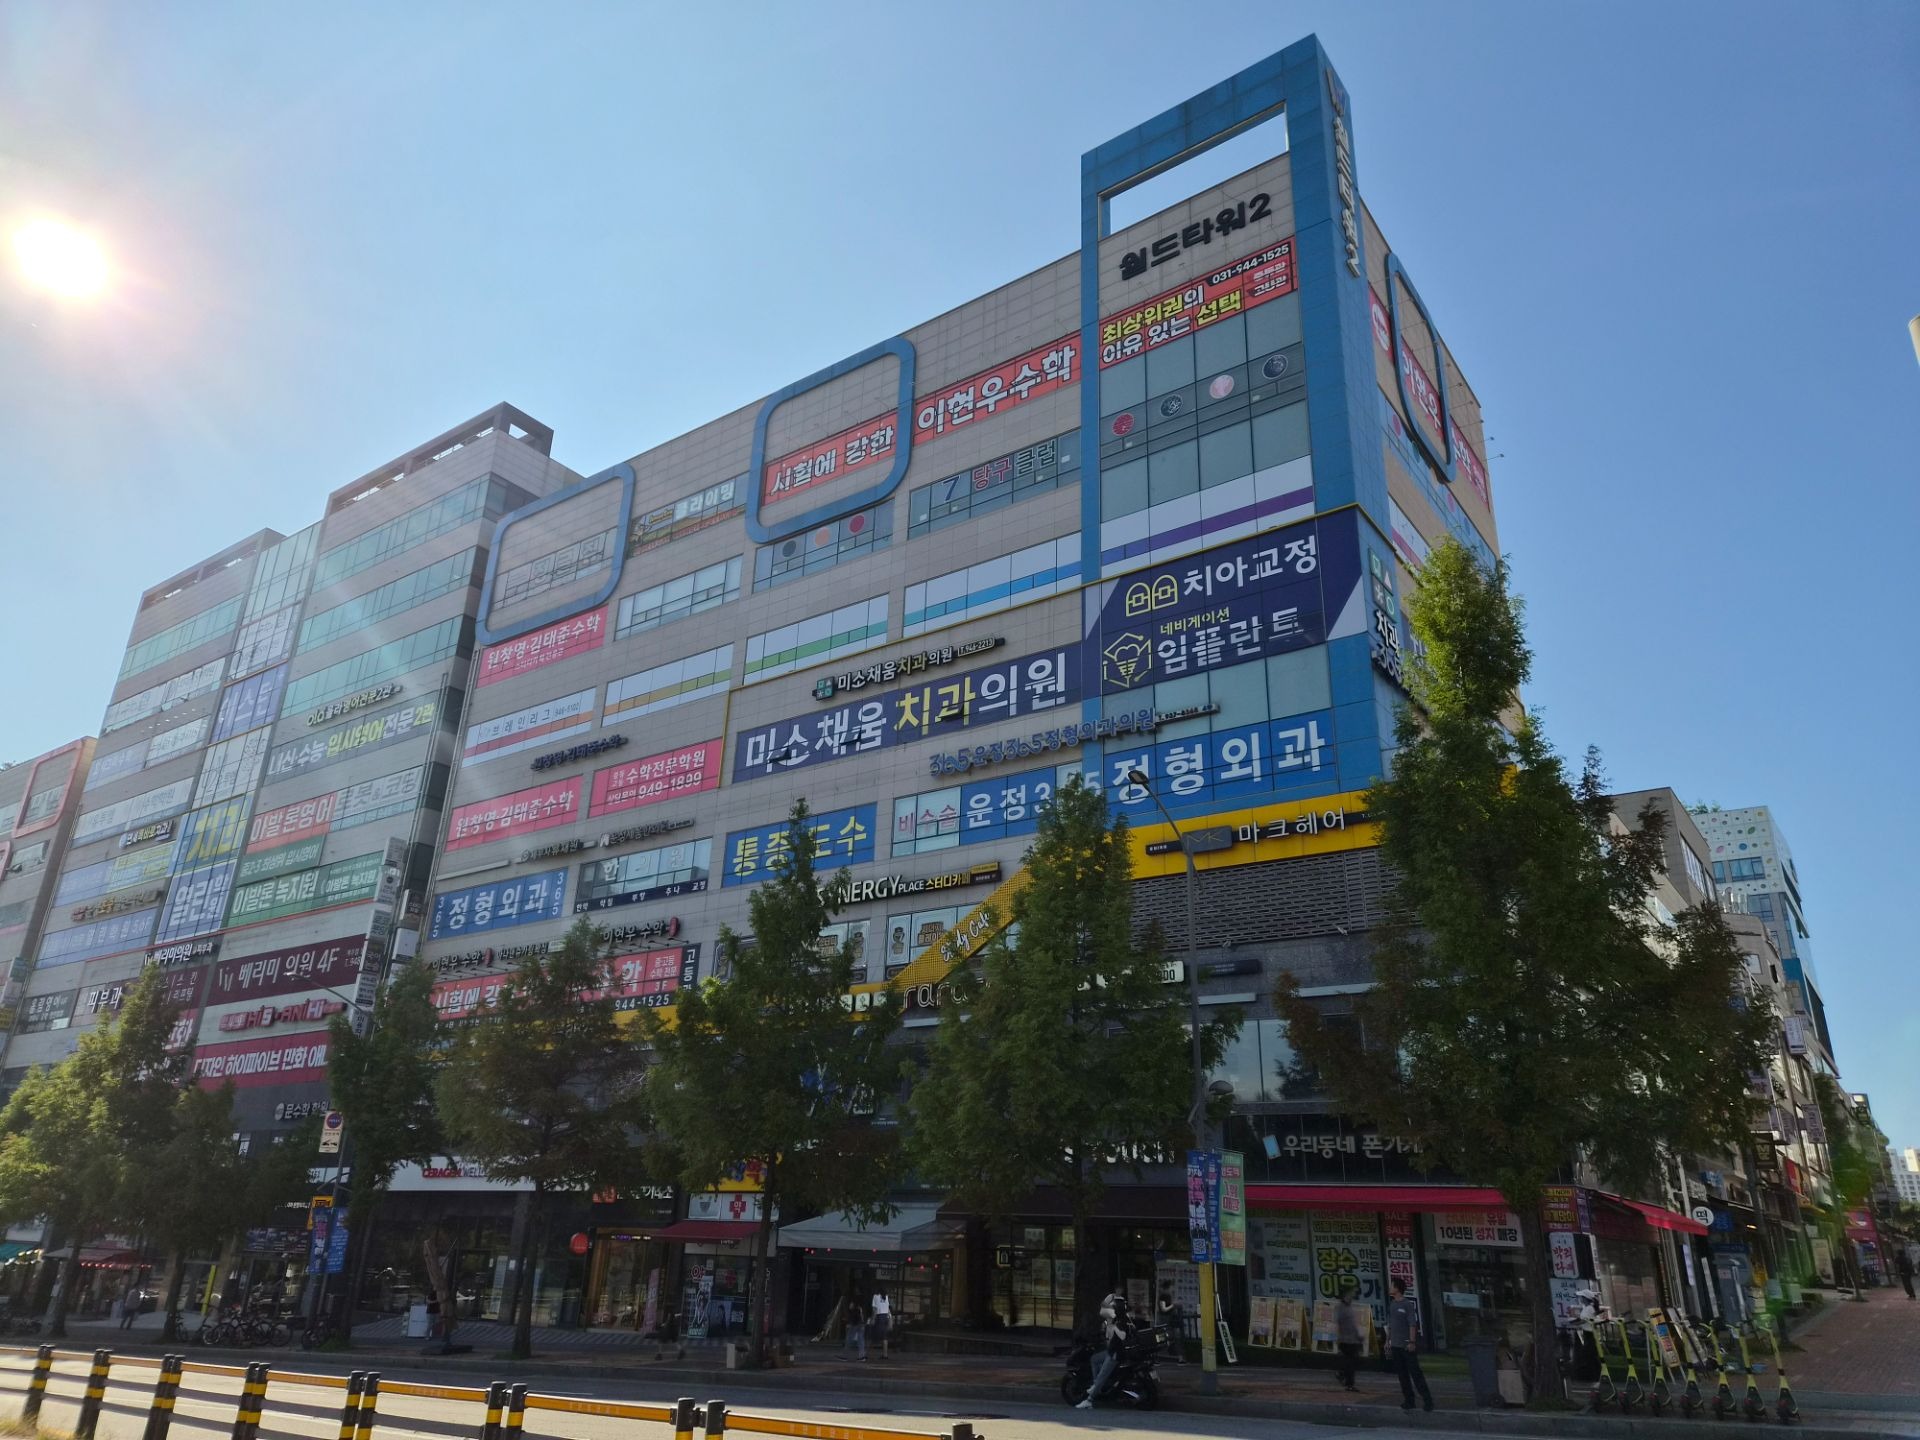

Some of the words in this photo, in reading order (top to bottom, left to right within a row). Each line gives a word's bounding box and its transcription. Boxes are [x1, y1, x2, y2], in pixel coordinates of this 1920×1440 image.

[1120, 192, 1271, 280] 월드타워2
[1212, 244, 1289, 284] 031-944-1525
[1102, 286, 1204, 344] 최상위권의
[1102, 333, 1143, 362] 이유
[1148, 317, 1191, 345] 있는
[1196, 289, 1242, 325] 선택
[918, 340, 1076, 432] 이현우수학
[771, 449, 836, 494] 시험에
[846, 425, 894, 463] 강한
[943, 475, 960, 501] 7
[973, 438, 1056, 491] 당구클럽
[1184, 535, 1317, 597] 치아교정
[1160, 606, 1230, 635] 네비게이션
[1158, 607, 1303, 674] 임플란트
[838, 647, 952, 691] 미소채움치과의원
[745, 652, 1066, 772] 미소채움치과의원
[626, 749, 705, 783] 수학전문학원
[1112, 720, 1325, 805] 정형외과
[899, 804, 957, 836] 비수술
[1239, 807, 1345, 843] 마크헤어
[275, 870, 319, 903] 녹지원
[816, 874, 903, 907] SNERGY
[898, 880, 925, 893] PLACE
[925, 872, 971, 890] 스터디카페
[449, 880, 548, 930] 정형외과
[239, 957, 280, 988] 베리미
[284, 950, 314, 977] 의원
[318, 948, 340, 973] 4F
[87, 987, 123, 1013] 피부과
[435, 985, 480, 1014] 시험에
[615, 994, 669, 1011] 944-1525
[655, 981, 667, 992] 3F
[225, 1051, 281, 1074] 하이파이브
[282, 1049, 307, 1068] 만화
[285, 1102, 310, 1119] 문수학
[1283, 1134, 1356, 1157] 우리동네
[422, 1167, 462, 1179] CERAGEM
[1385, 1224, 1412, 1235] SALE
[1440, 1226, 1473, 1240] 10년된
[1475, 1227, 1496, 1241] 성지
[1497, 1228, 1517, 1242] 매장
[1316, 1247, 1359, 1273] 장수
[1359, 1248, 1379, 1260] 하는
[1360, 1261, 1380, 1273] 곳은
[1390, 1261, 1413, 1274] 성지
